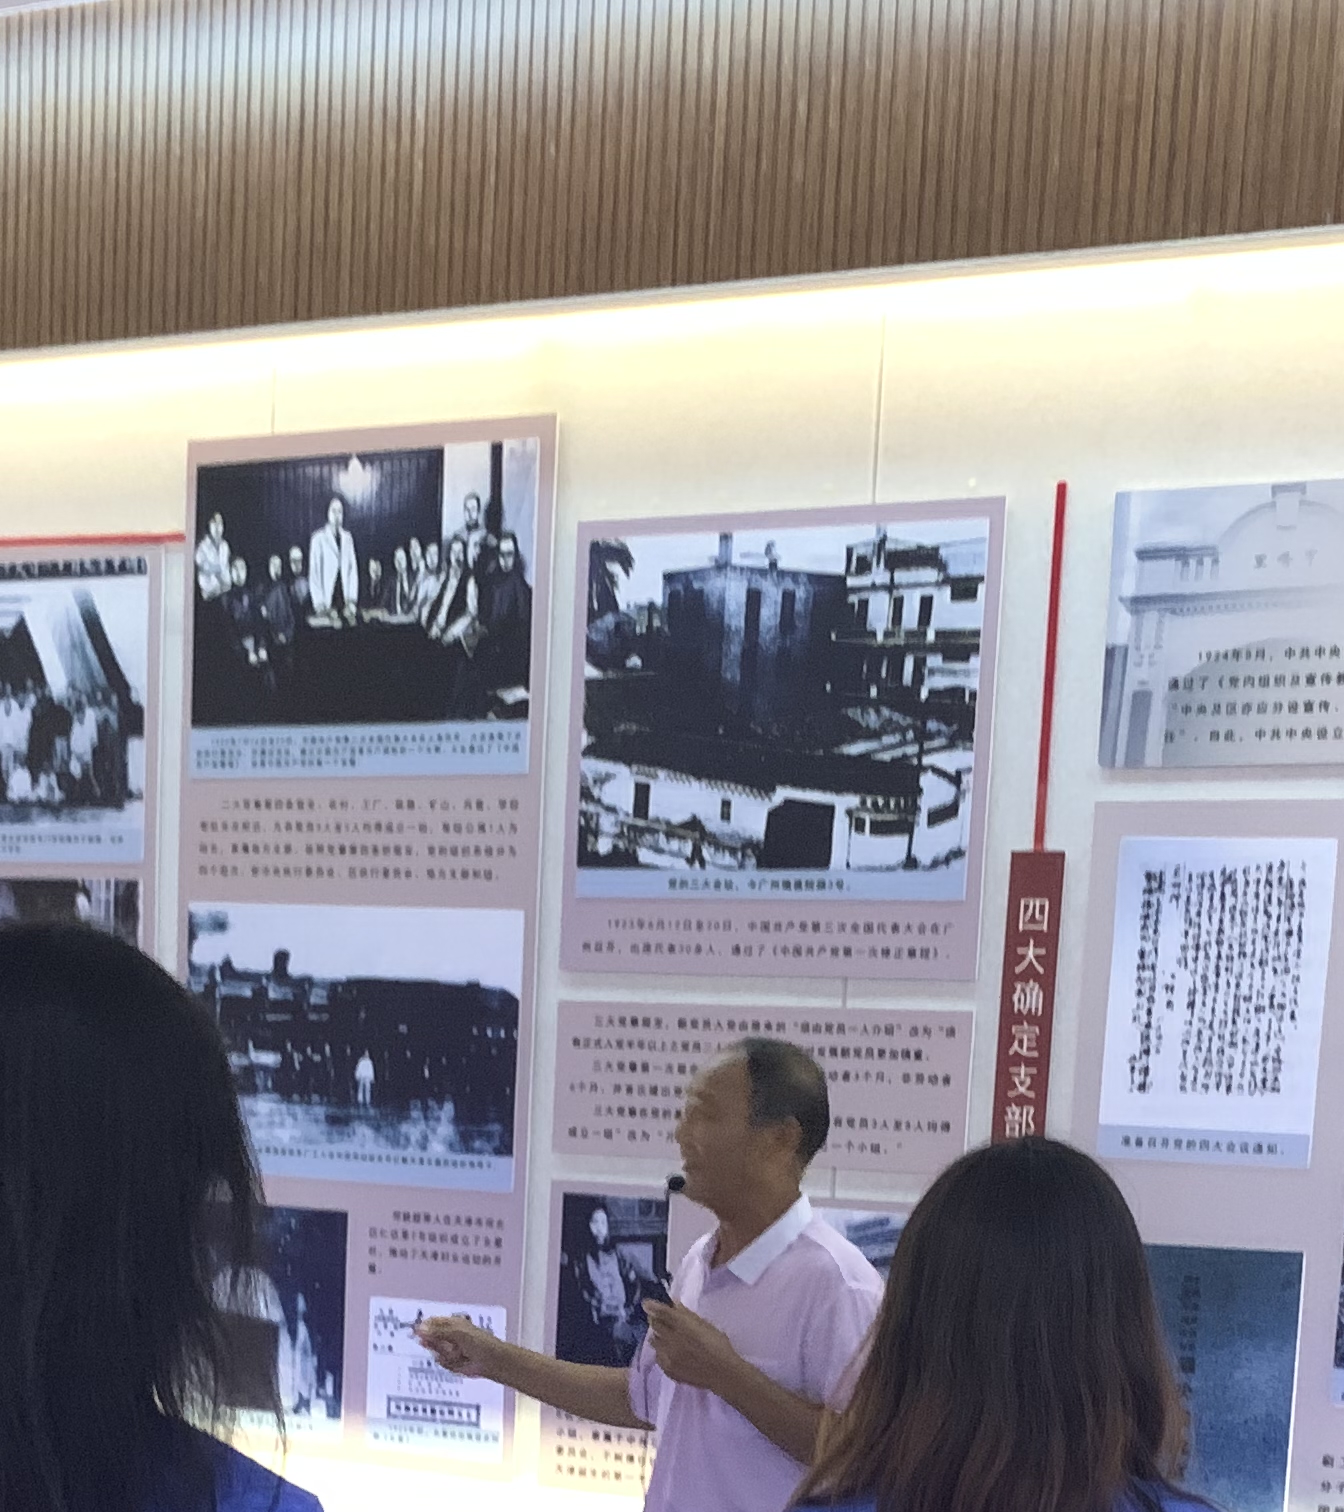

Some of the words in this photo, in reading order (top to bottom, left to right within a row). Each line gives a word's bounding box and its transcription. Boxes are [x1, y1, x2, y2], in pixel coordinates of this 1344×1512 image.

[1005, 897, 1050, 1138] 四大确定支部
